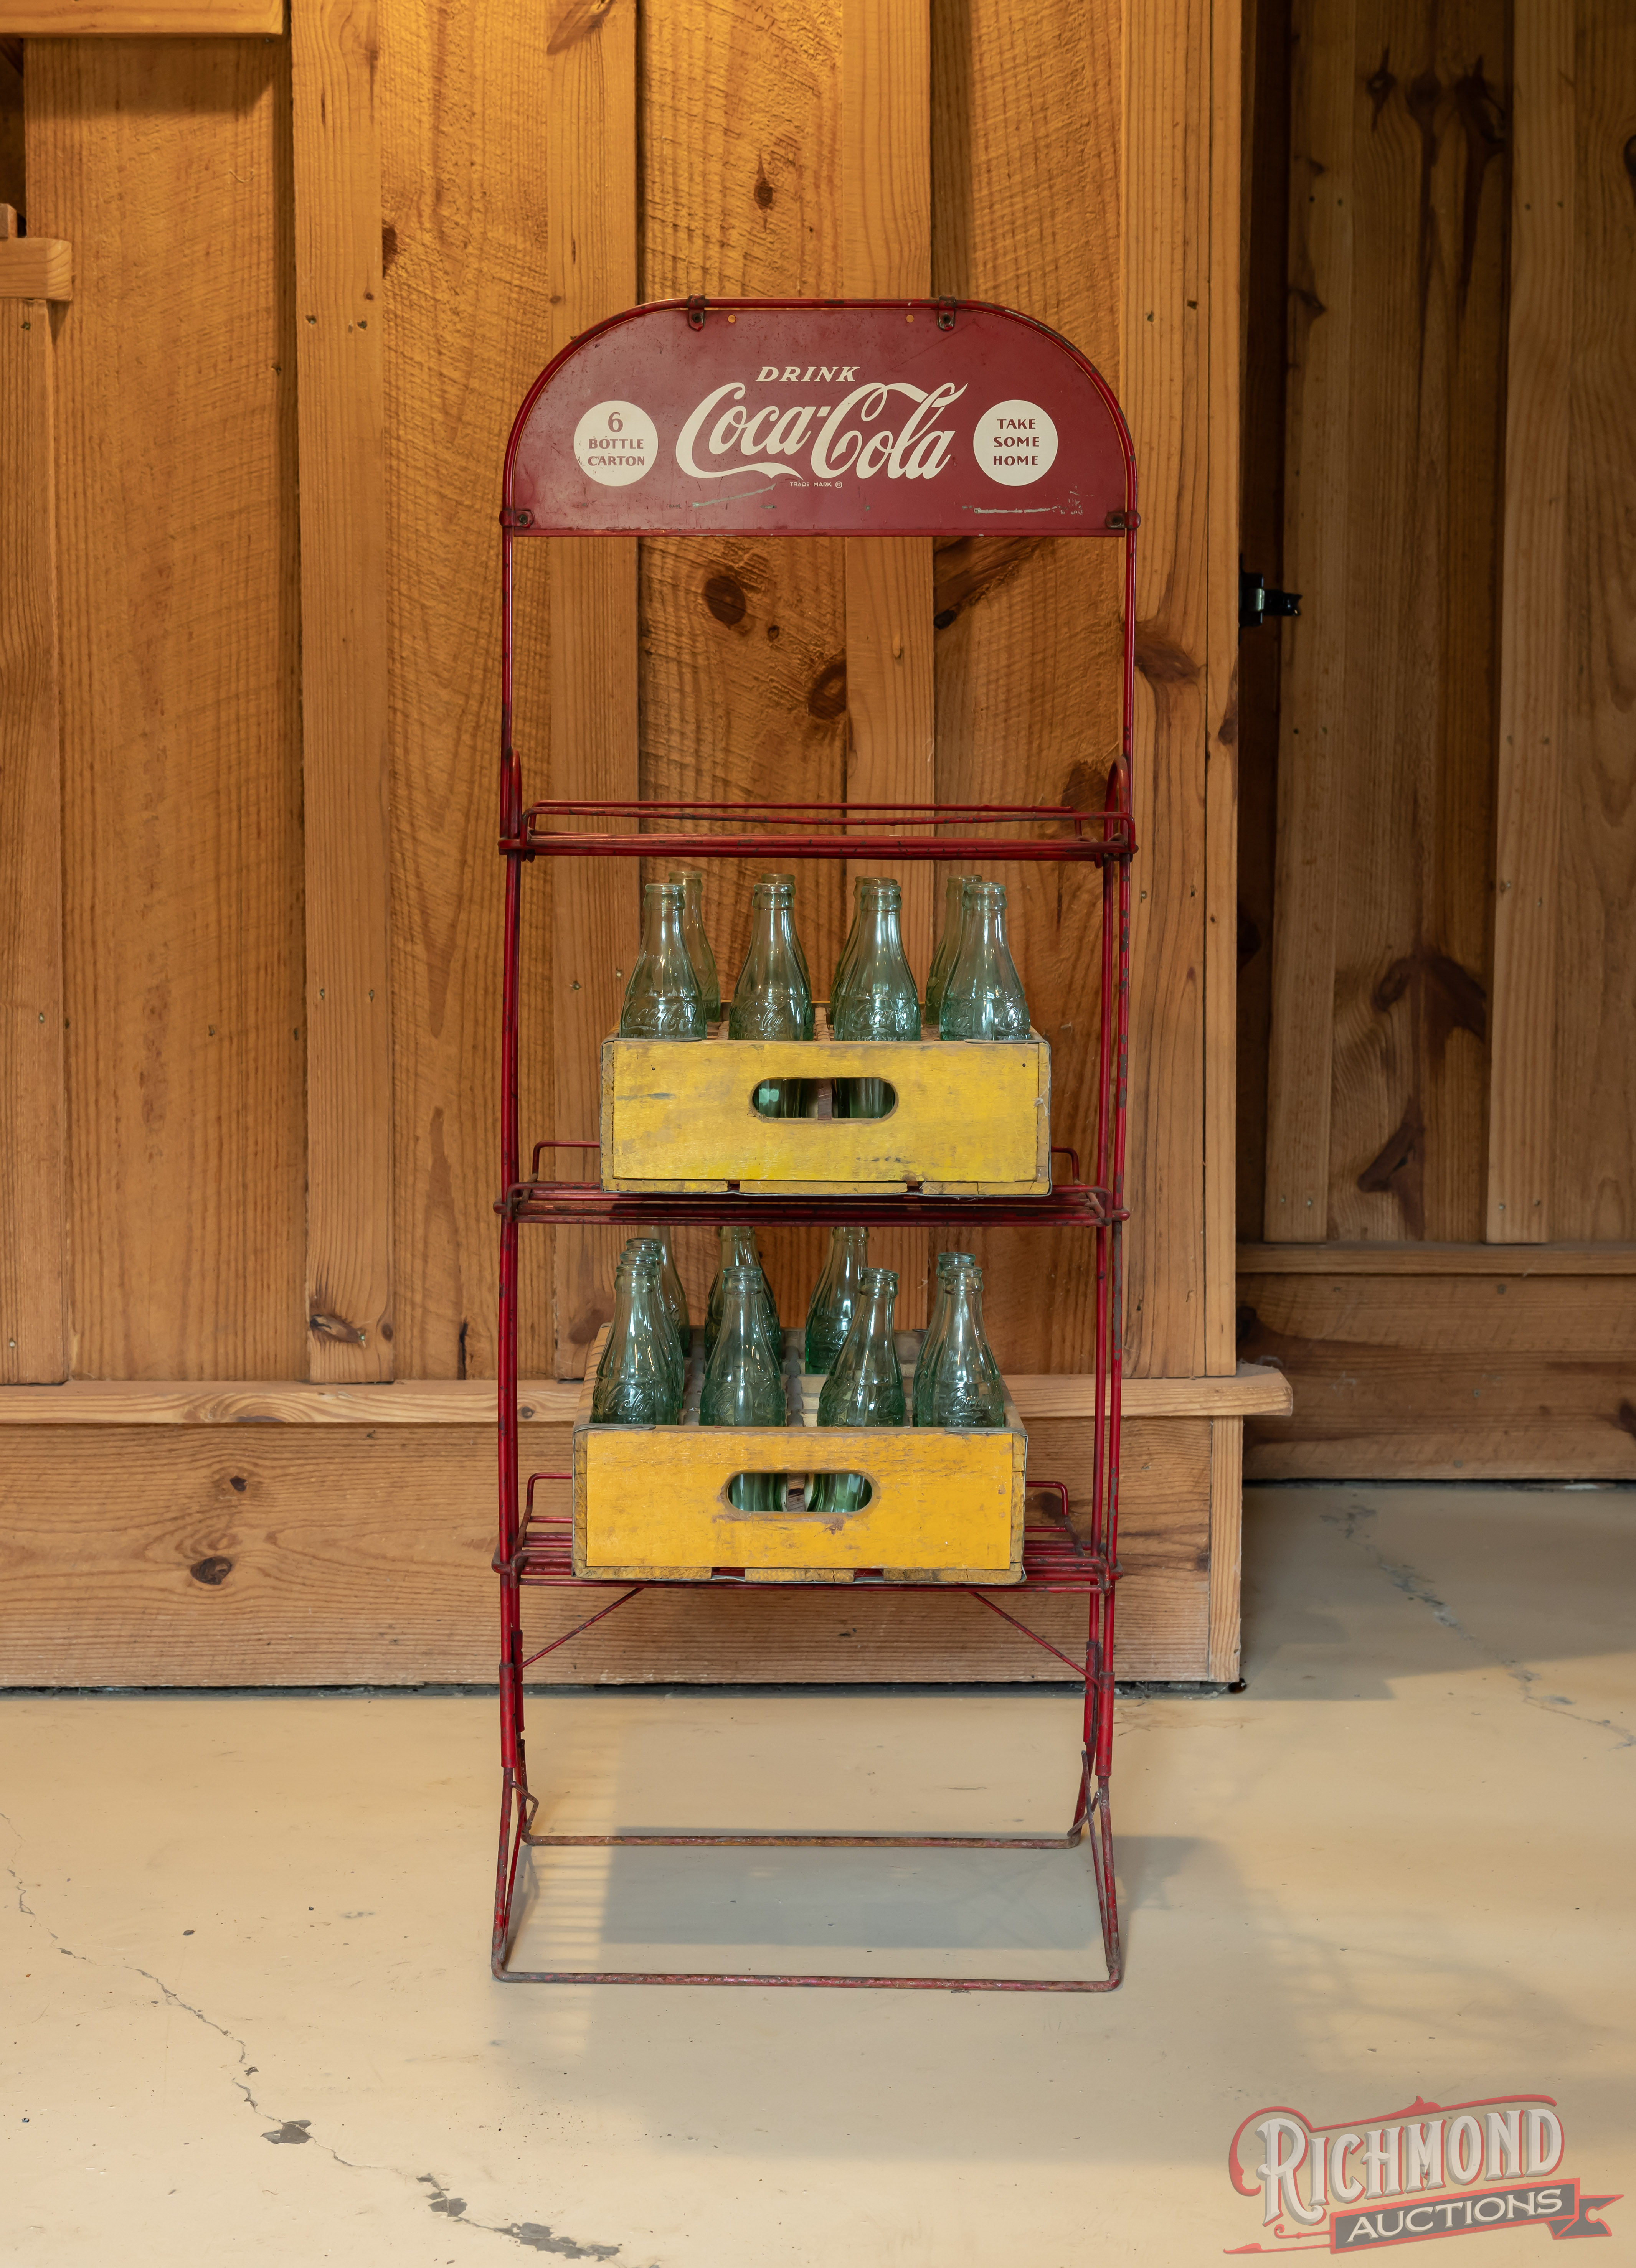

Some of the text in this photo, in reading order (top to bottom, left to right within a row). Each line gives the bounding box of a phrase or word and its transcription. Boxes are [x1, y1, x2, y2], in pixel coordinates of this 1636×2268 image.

[755, 366, 860, 382] DRINK
[608, 411, 624, 433] 6
[997, 419, 1036, 429] TAKE
[675, 382, 969, 481] Coca-Cola
[589, 439, 644, 449] BOTTLE
[993, 437, 1040, 447] SOME
[587, 455, 645, 466] CARTON
[993, 455, 1038, 466] HOME
